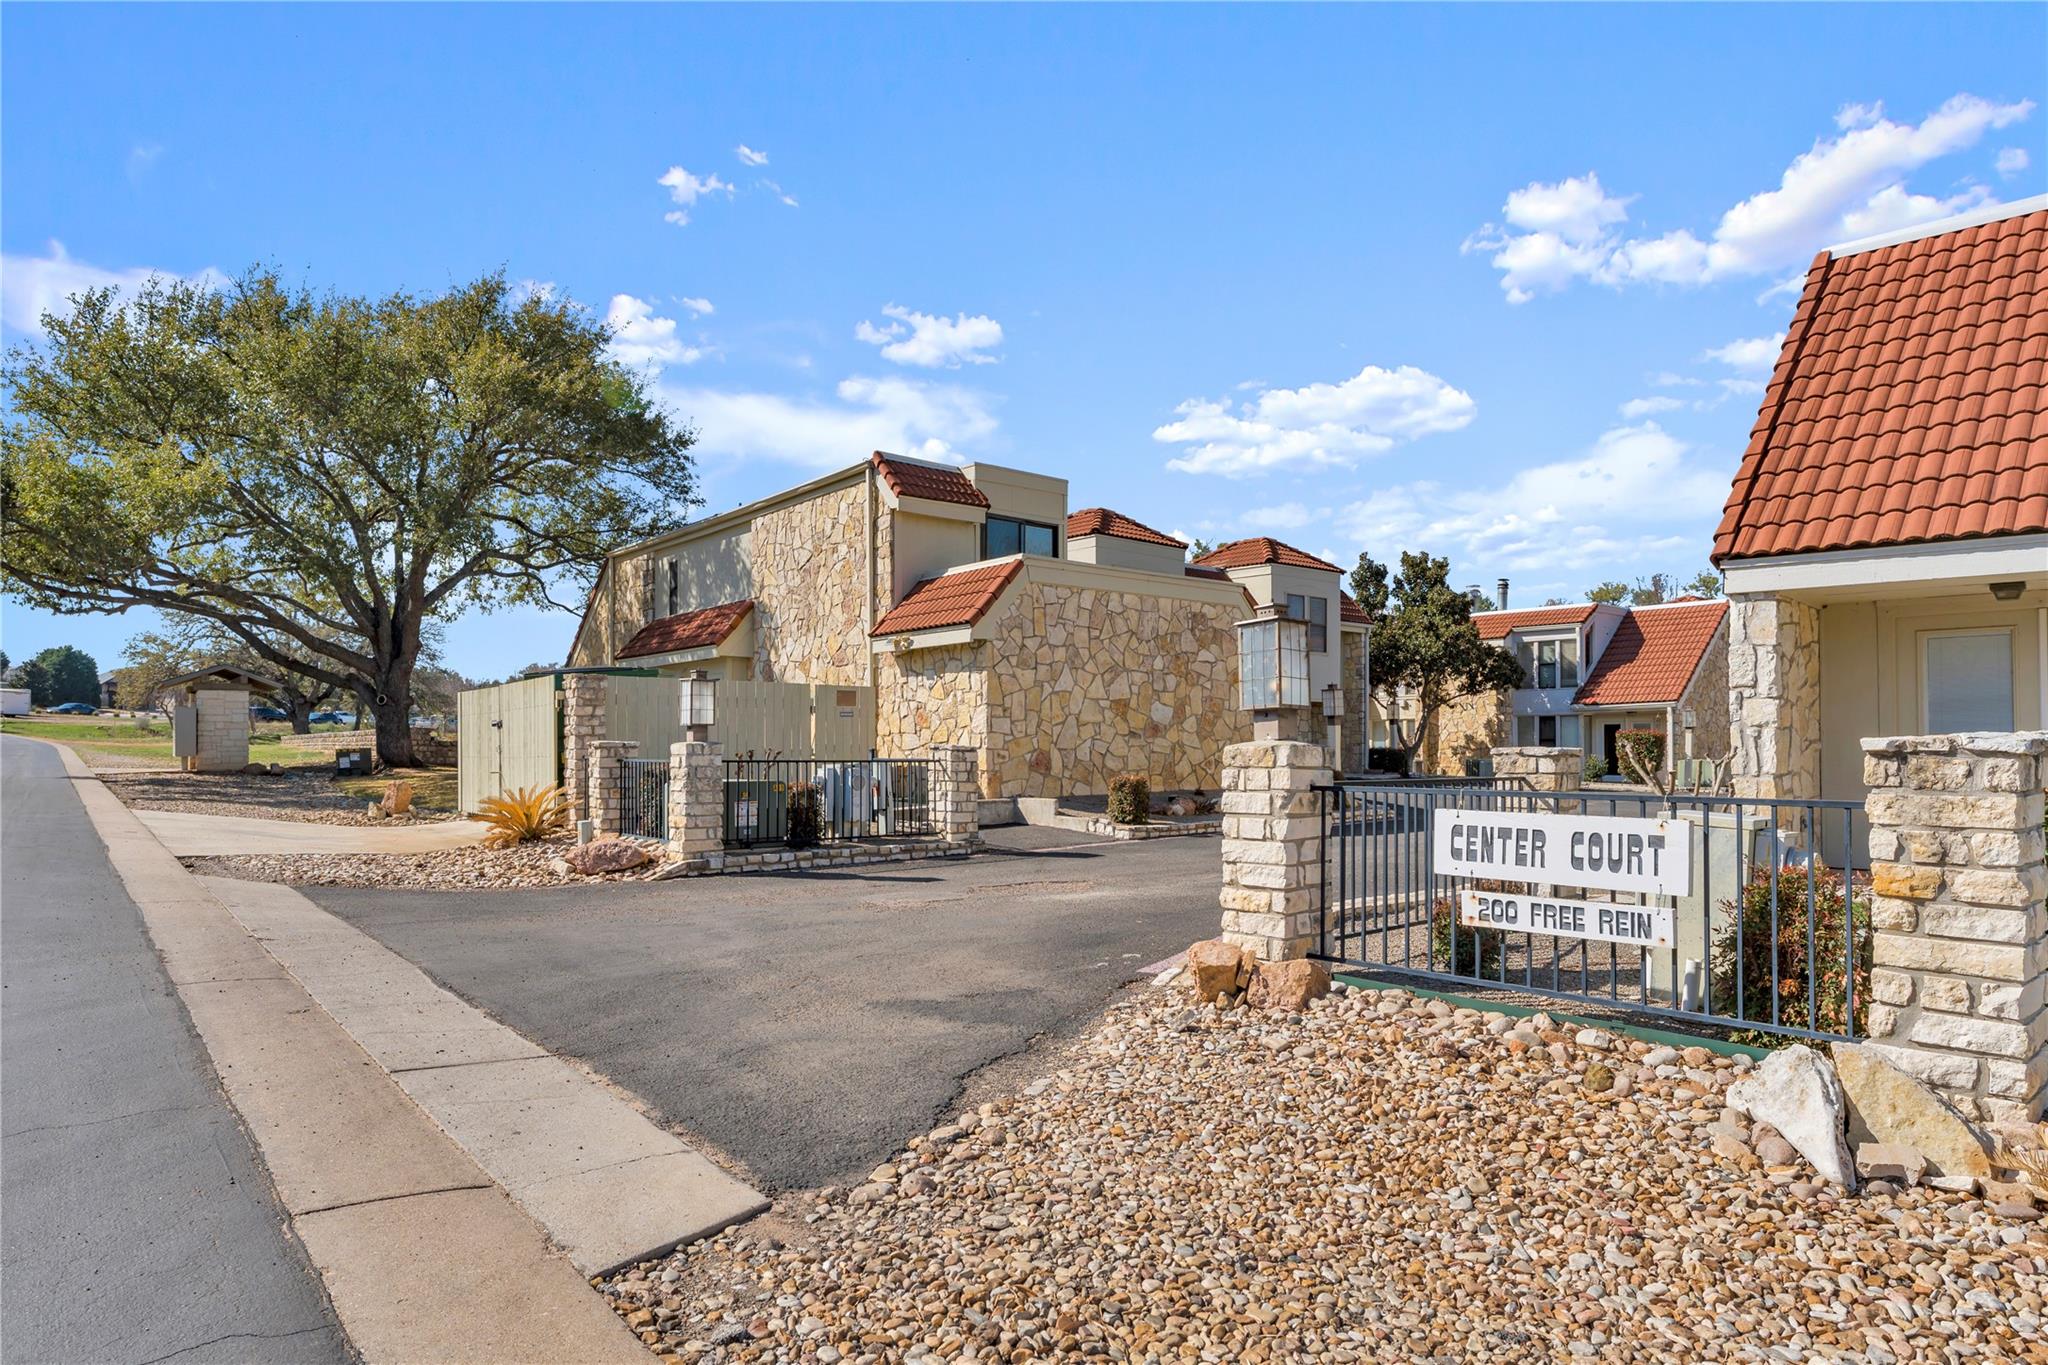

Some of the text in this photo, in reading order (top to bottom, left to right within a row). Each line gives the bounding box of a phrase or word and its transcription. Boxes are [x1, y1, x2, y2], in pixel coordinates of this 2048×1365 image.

[1450, 824, 1665, 877] CENTER COURT
[1478, 897, 1652, 940] 200 FREE REIN
